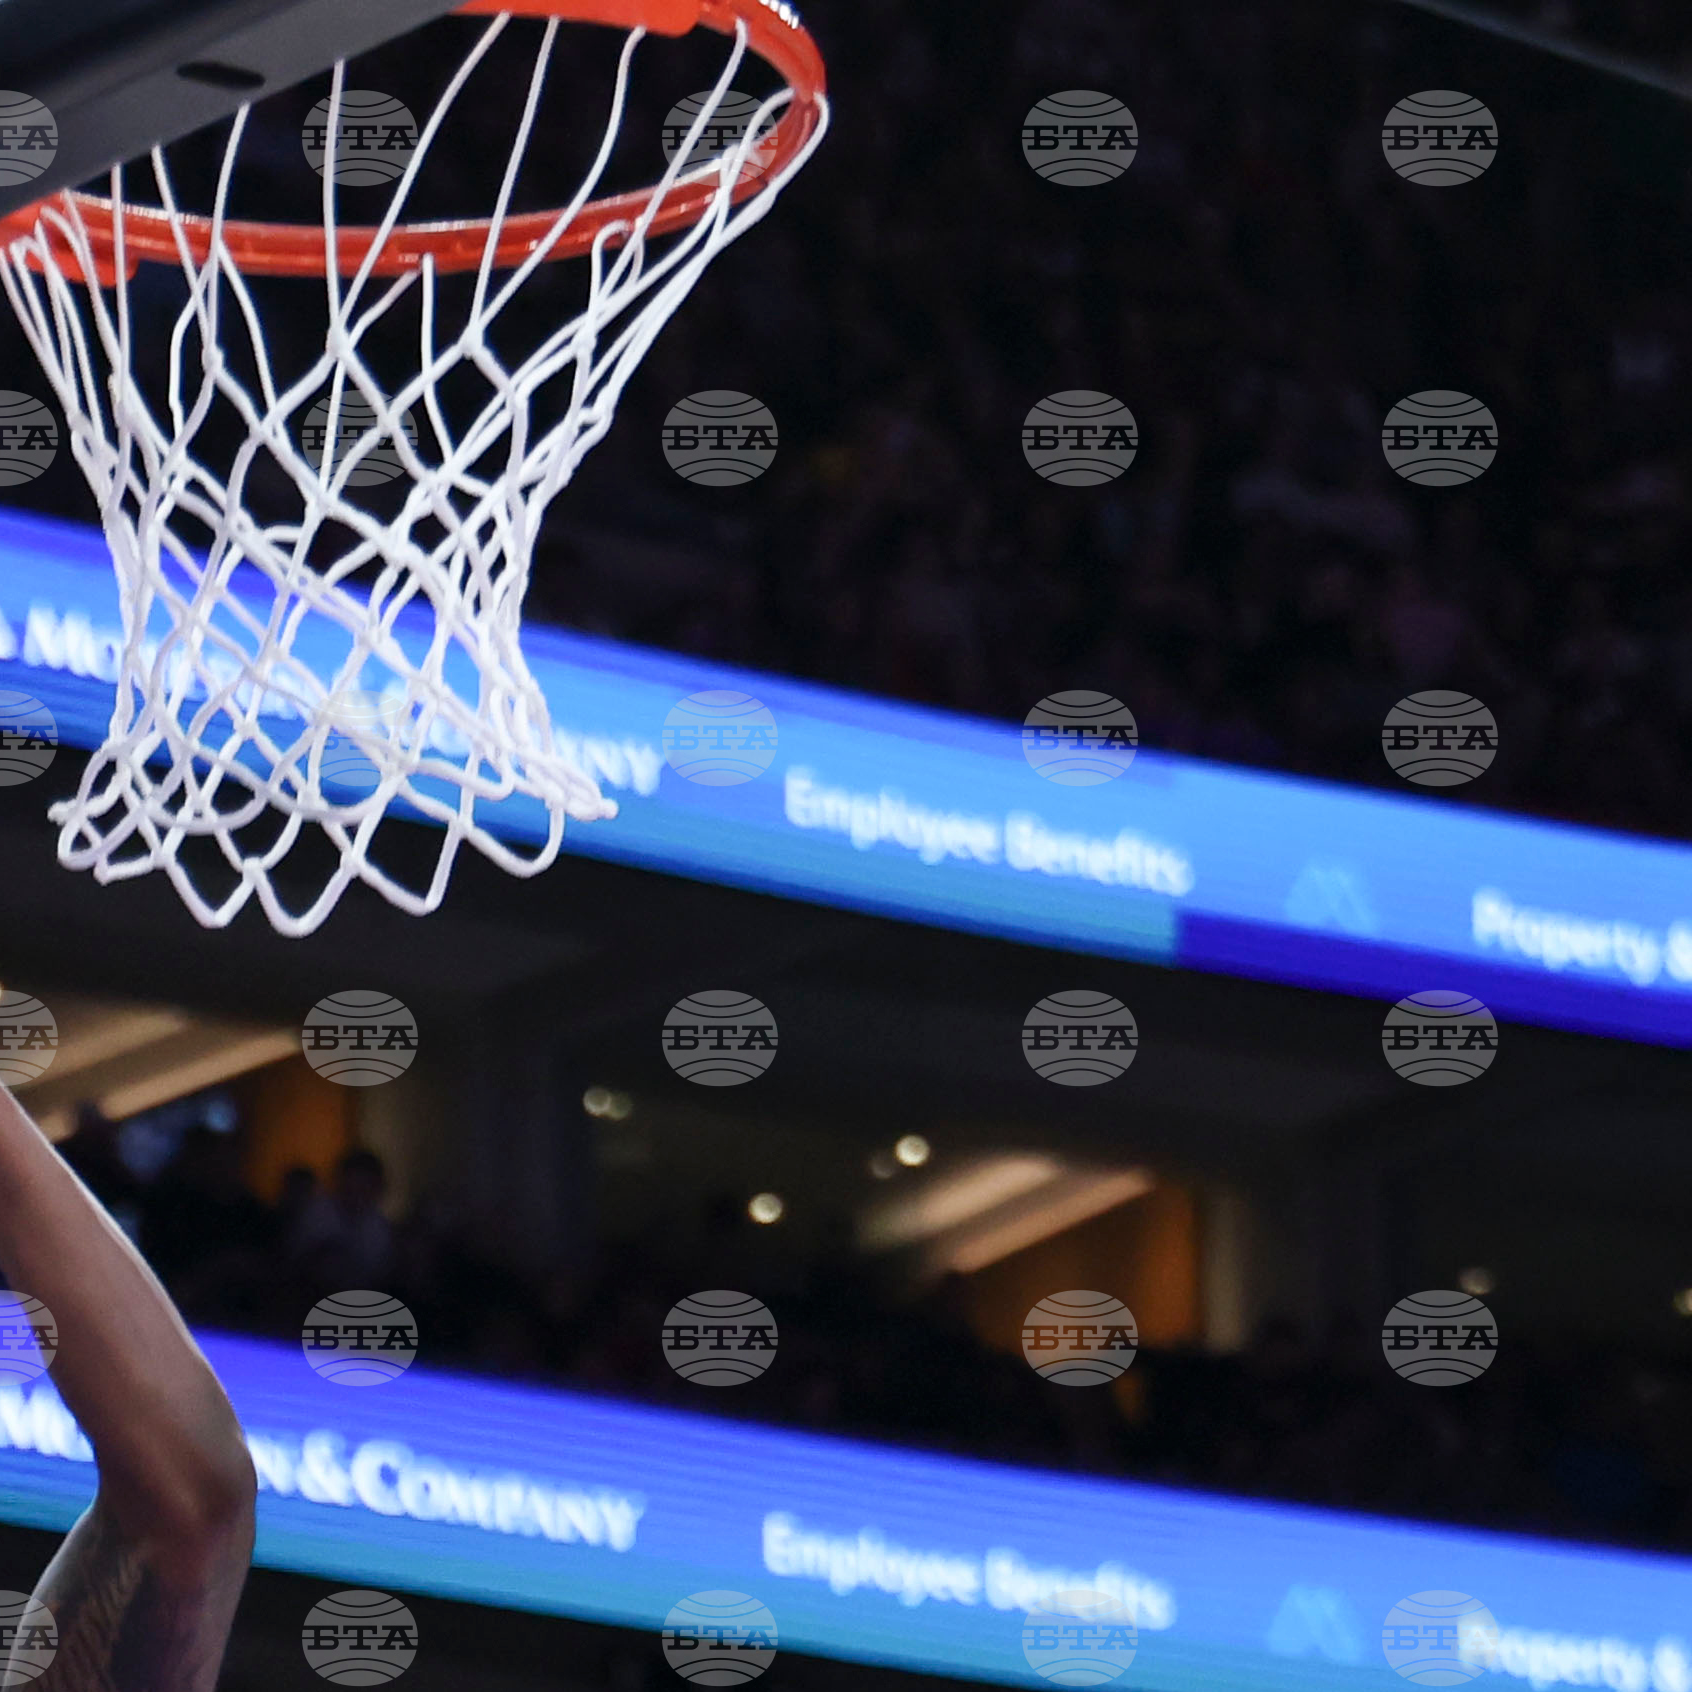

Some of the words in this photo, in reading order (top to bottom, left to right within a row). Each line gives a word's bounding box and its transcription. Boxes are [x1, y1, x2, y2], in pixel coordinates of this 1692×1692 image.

[784, 765, 1002, 867] Employee
[1005, 809, 1195, 897] Benefits
[1471, 886, 1661, 987] Property
[762, 1511, 980, 1608] Employee
[983, 1546, 1177, 1631] Benefits
